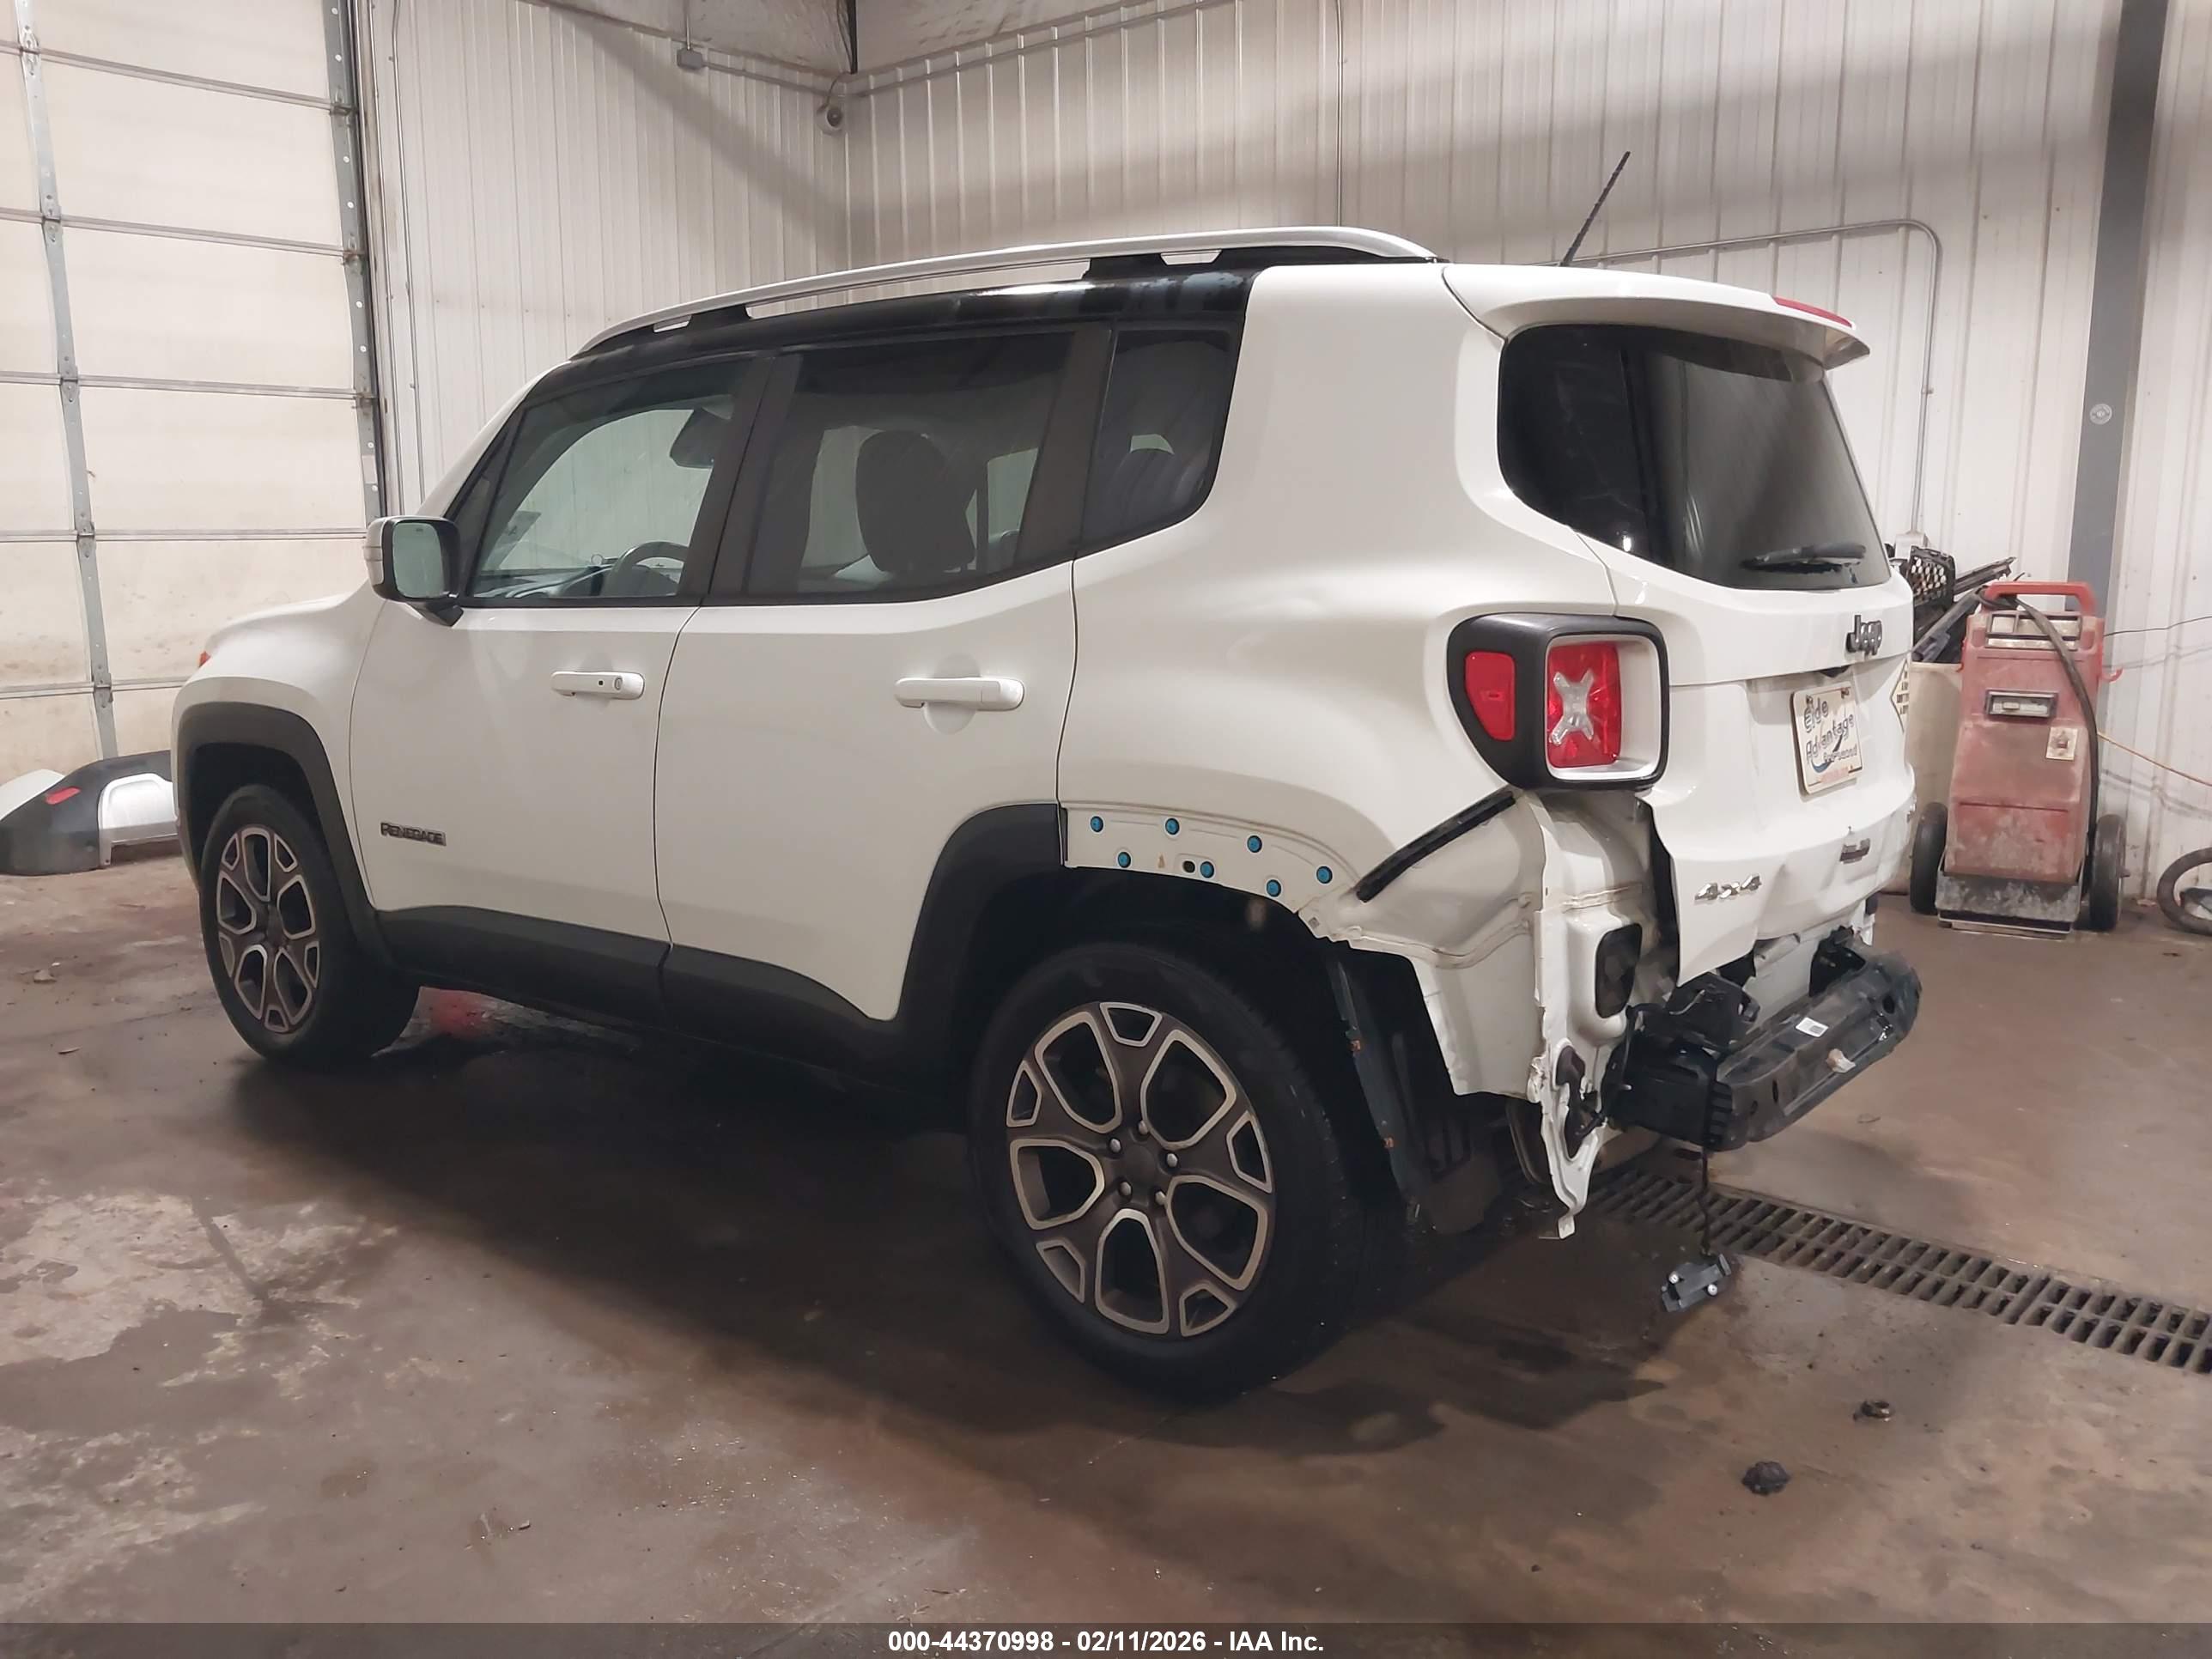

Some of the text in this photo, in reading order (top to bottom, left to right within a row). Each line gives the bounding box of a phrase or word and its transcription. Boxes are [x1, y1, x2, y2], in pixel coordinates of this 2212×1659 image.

[1845, 614, 1882, 656] Jeep
[1804, 697, 1828, 733] Eide
[1806, 714, 1855, 763] Advantage
[380, 822, 447, 847] RENEGADE
[1694, 875, 1762, 901] 4x4
